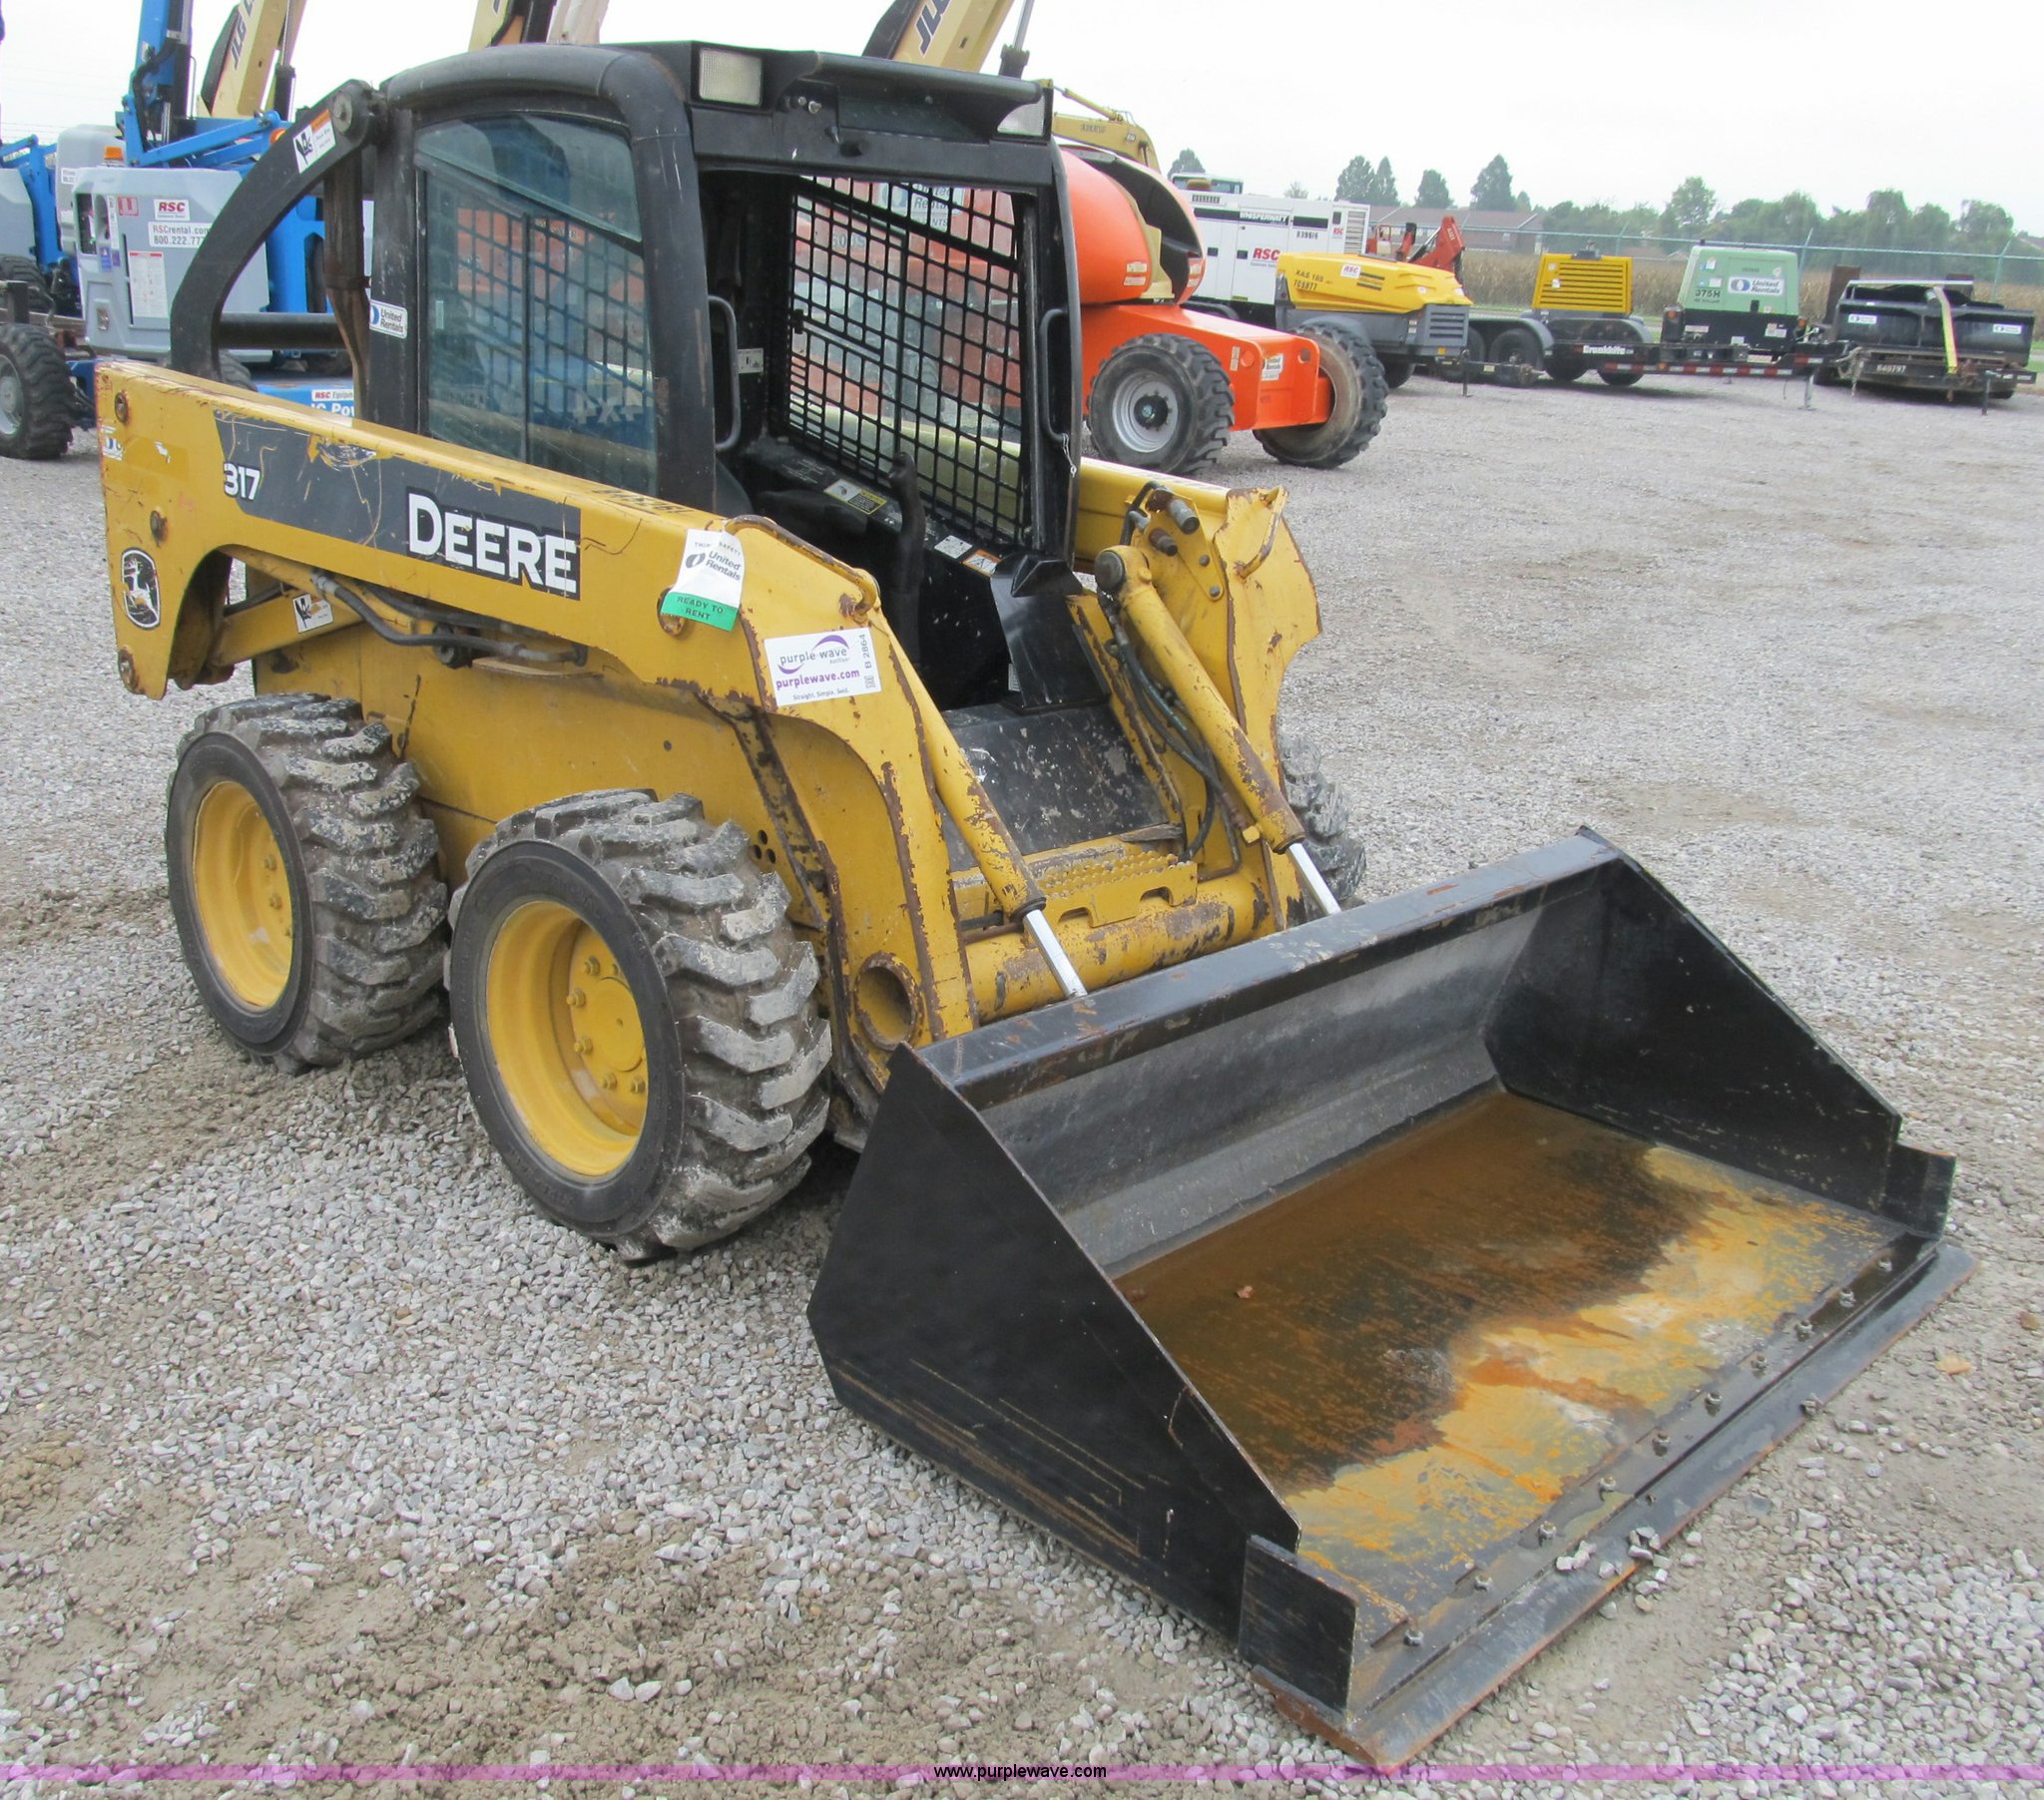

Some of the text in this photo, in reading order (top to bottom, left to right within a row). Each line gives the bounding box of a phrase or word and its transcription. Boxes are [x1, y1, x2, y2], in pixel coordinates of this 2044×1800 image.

[159, 202, 186, 212] RSC
[1253, 247, 1280, 260] RSC
[380, 307, 402, 321] United
[379, 318, 403, 333] Rentals
[224, 462, 260, 500] 317
[407, 491, 577, 594] DEERE
[706, 559, 741, 581] Rentals
[709, 551, 742, 571] United
[677, 596, 724, 614] READY TO
[685, 608, 711, 621] RENT
[779, 648, 847, 666] purple wave
[775, 670, 860, 690] purplewave.com
